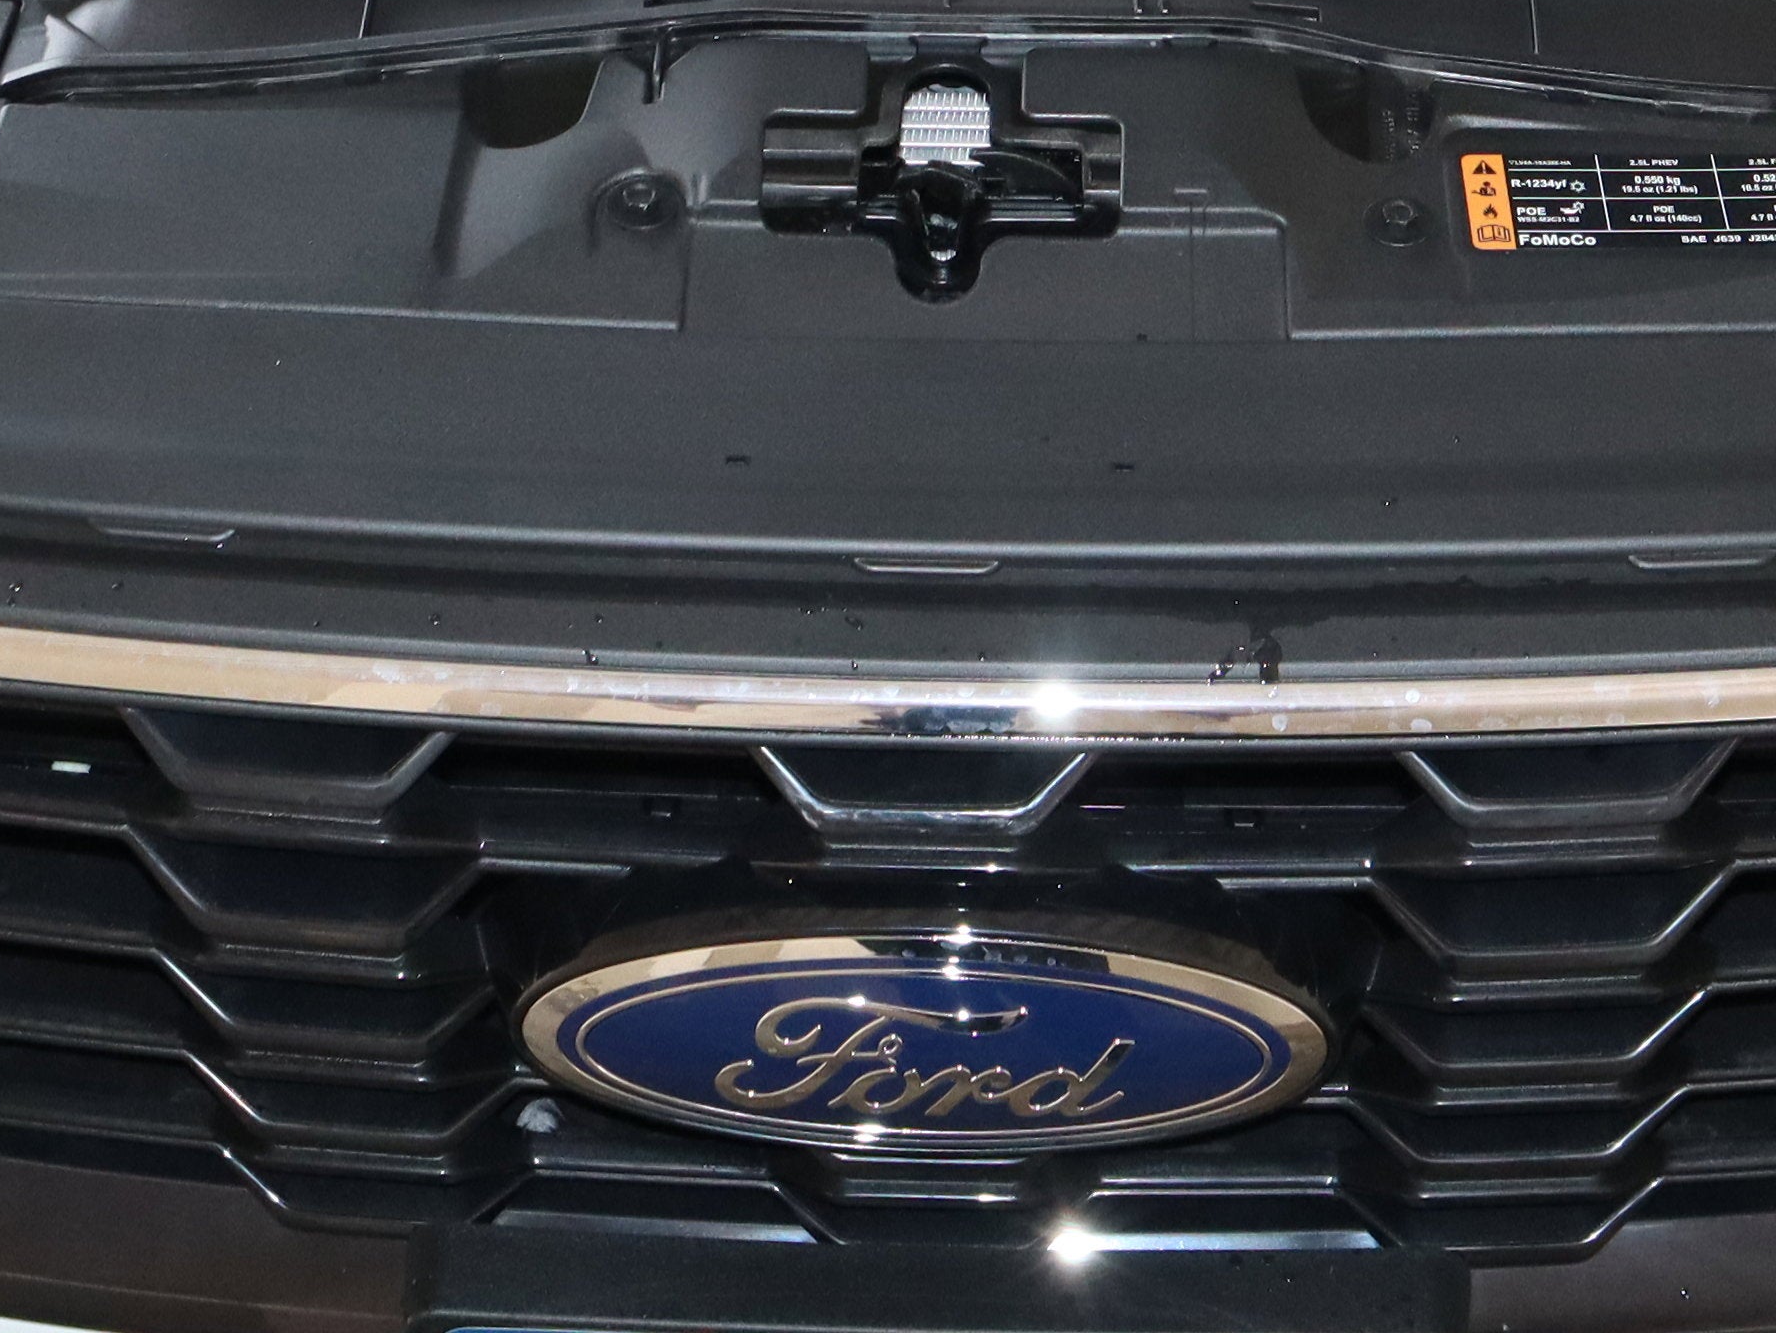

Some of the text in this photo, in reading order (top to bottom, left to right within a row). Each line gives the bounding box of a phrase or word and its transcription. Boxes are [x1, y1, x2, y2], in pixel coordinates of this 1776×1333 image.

[1511, 178, 1567, 190] R-1234yf
[1634, 175, 1681, 186] 0.550 kg
[1516, 206, 1546, 216] POE
[1653, 205, 1675, 214] POE
[1518, 233, 1597, 246] FoMoCo
[1681, 235, 1707, 243] SAE
[715, 995, 1135, 1119] Ford
